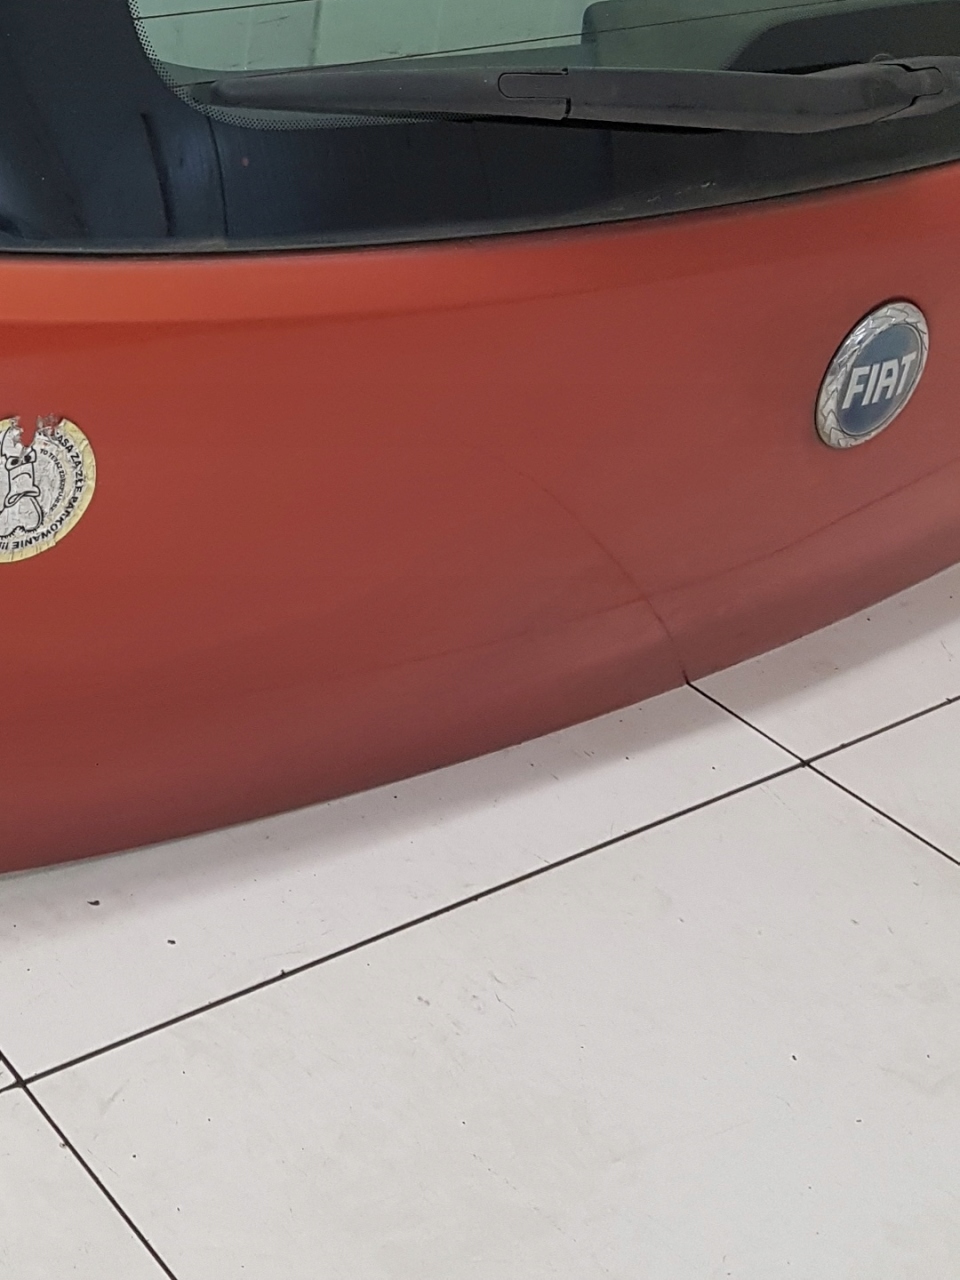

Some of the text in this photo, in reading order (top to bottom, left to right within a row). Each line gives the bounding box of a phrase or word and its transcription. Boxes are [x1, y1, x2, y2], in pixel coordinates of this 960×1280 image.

[841, 351, 918, 410] FIAT
[70, 452, 82, 468] ZA
[11, 496, 79, 549] PARKOWANIE
